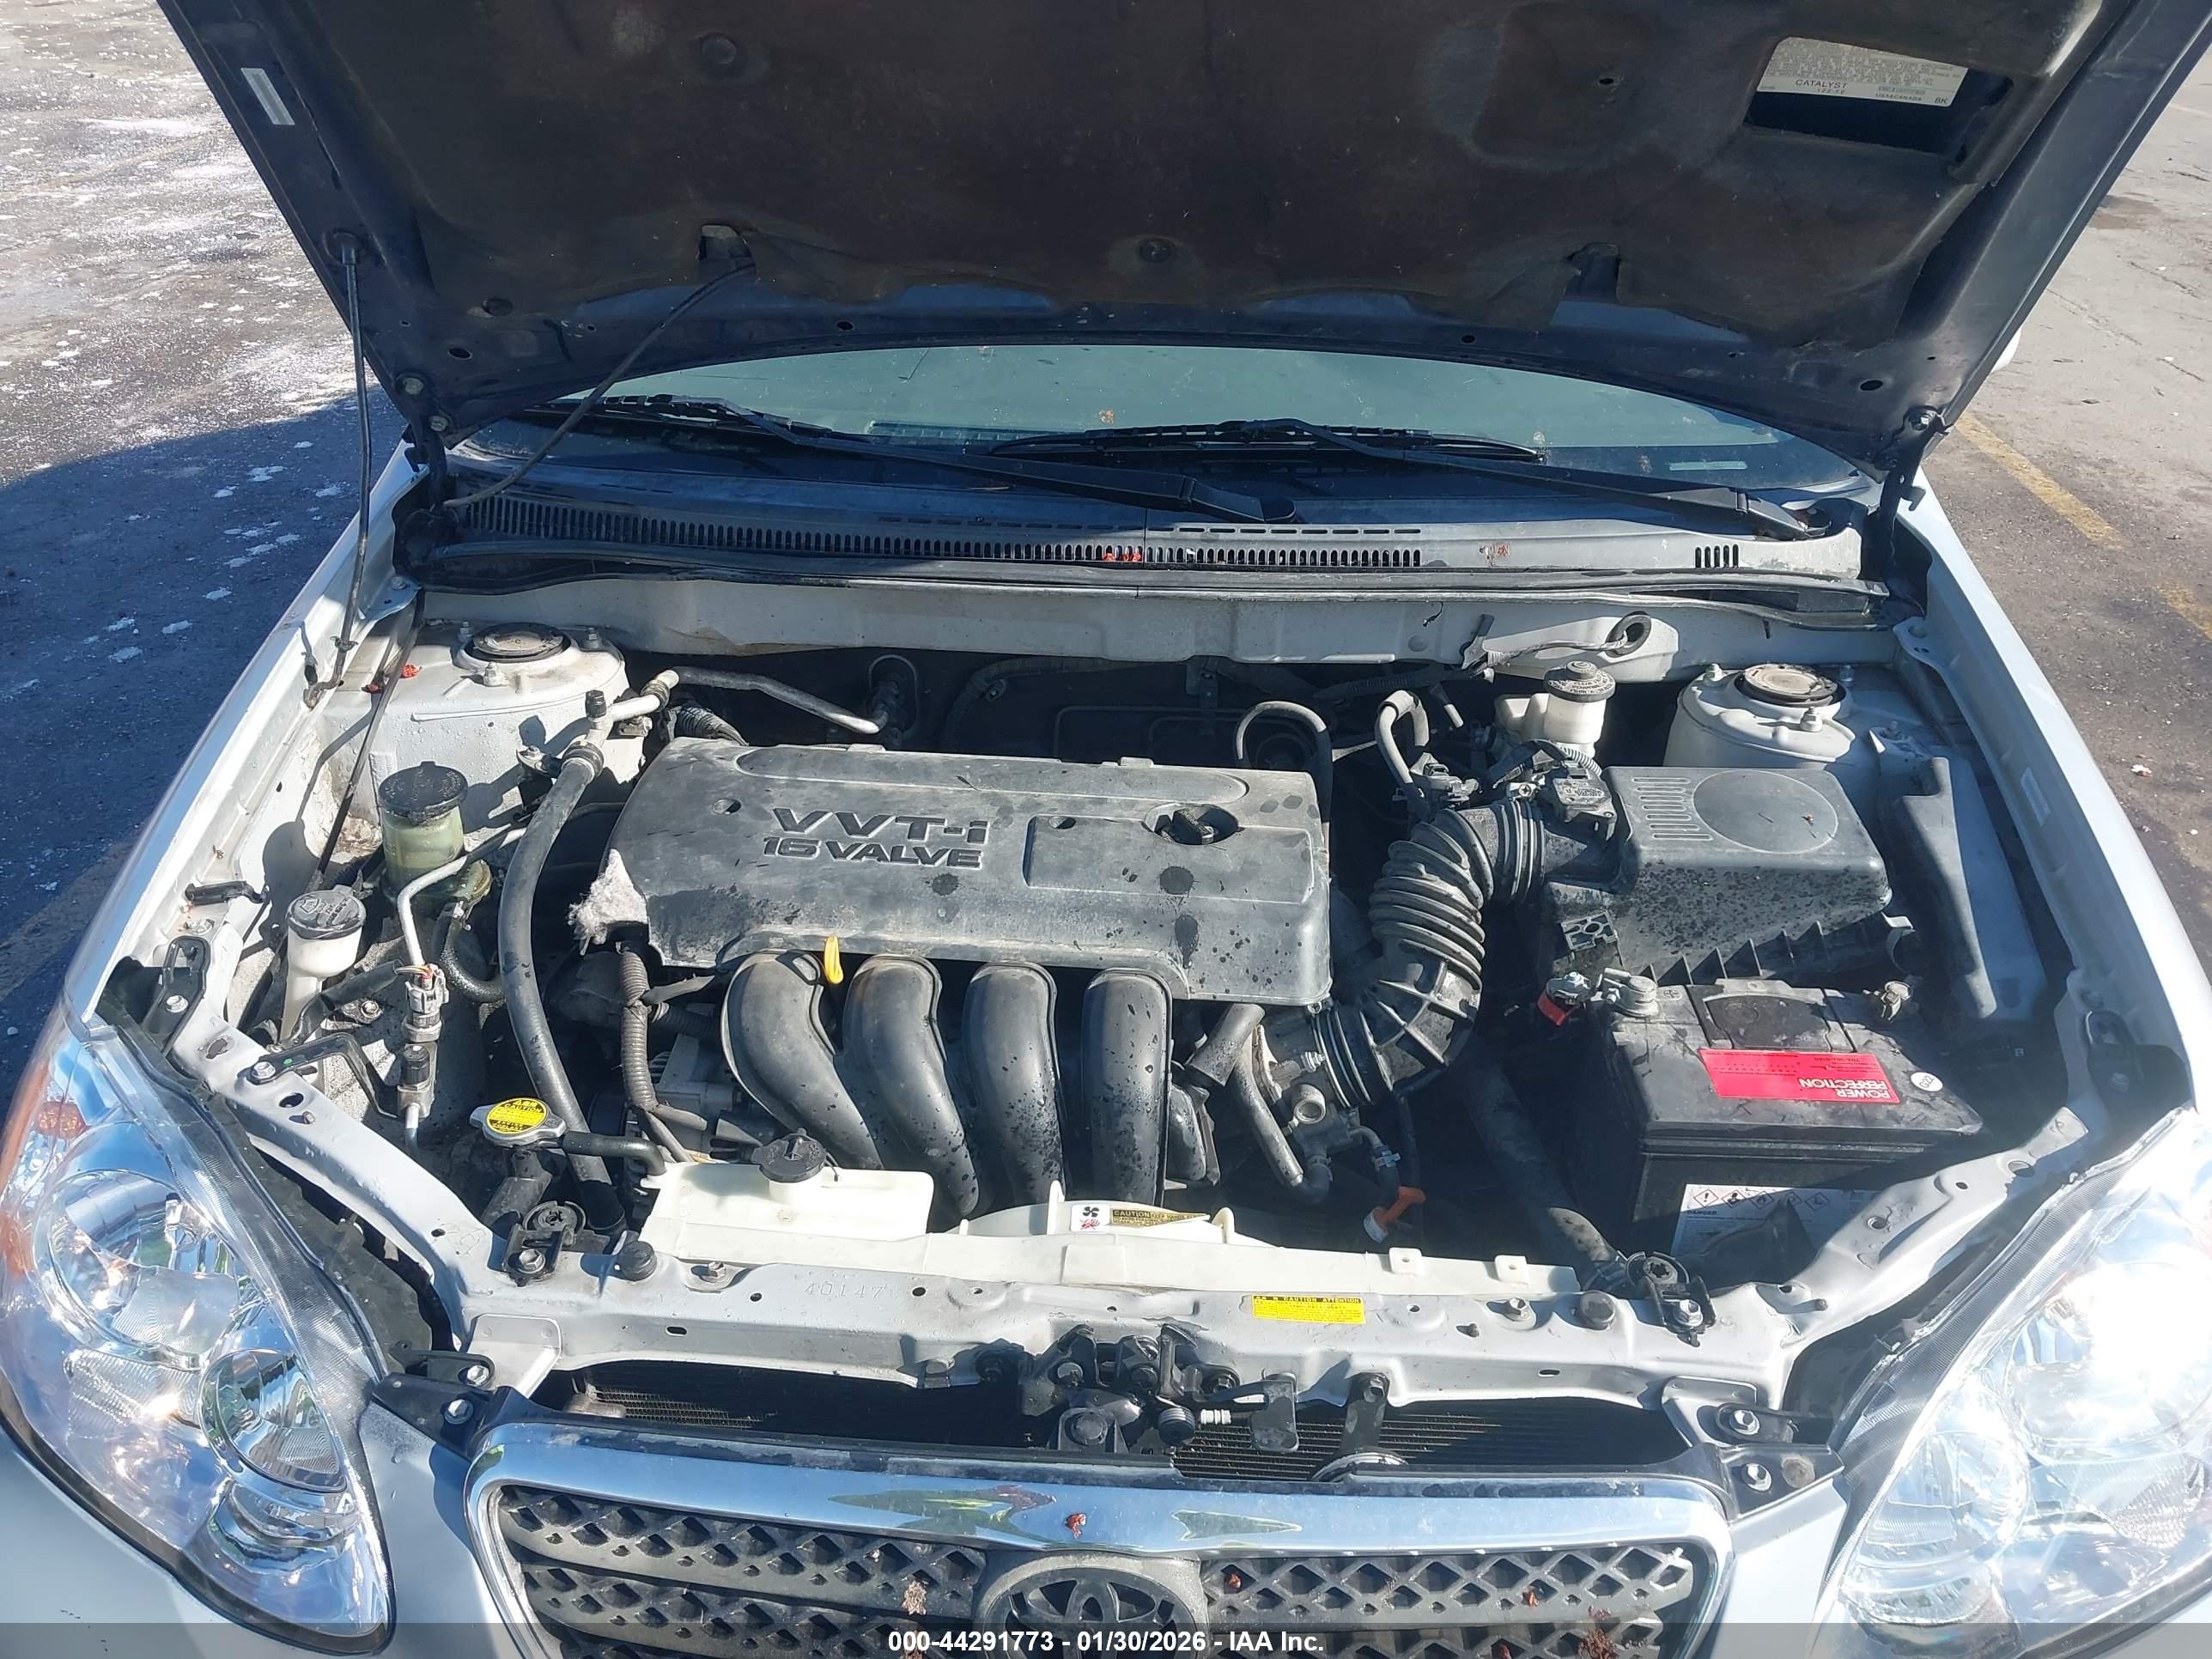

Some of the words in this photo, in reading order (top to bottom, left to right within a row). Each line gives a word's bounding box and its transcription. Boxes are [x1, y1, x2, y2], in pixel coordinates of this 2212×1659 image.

[1796, 78, 1848, 88] CATALYST
[763, 836, 822, 859] 16
[825, 840, 983, 870] VALVE
[1798, 1078, 1888, 1091] PERFECTION
[1834, 1089, 1892, 1100] POWER
[504, 1103, 543, 1114] CAUTION
